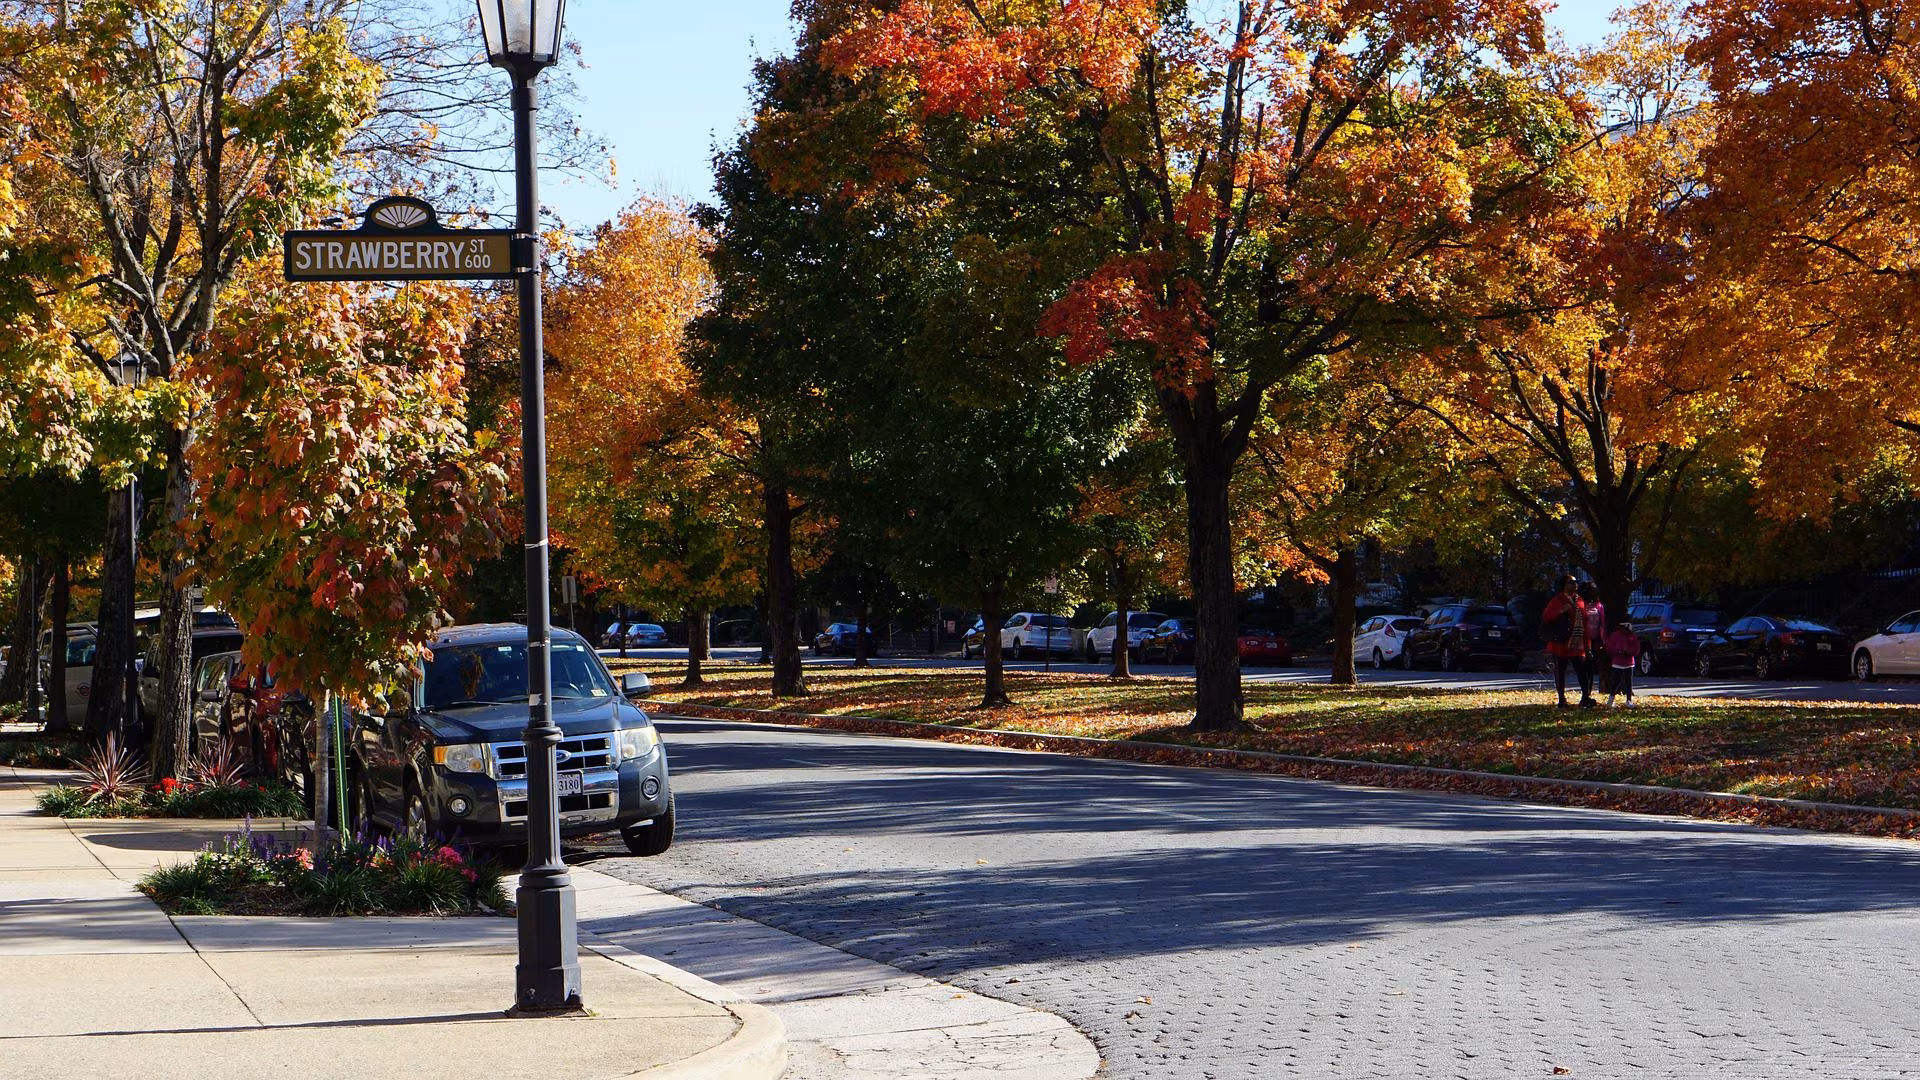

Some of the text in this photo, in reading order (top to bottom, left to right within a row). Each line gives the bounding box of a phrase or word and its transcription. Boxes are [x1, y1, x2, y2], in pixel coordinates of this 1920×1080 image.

[295, 239, 486, 270] STRAWBERRY ST
[464, 254, 491, 269] 600
[558, 780, 579, 791] 3180
